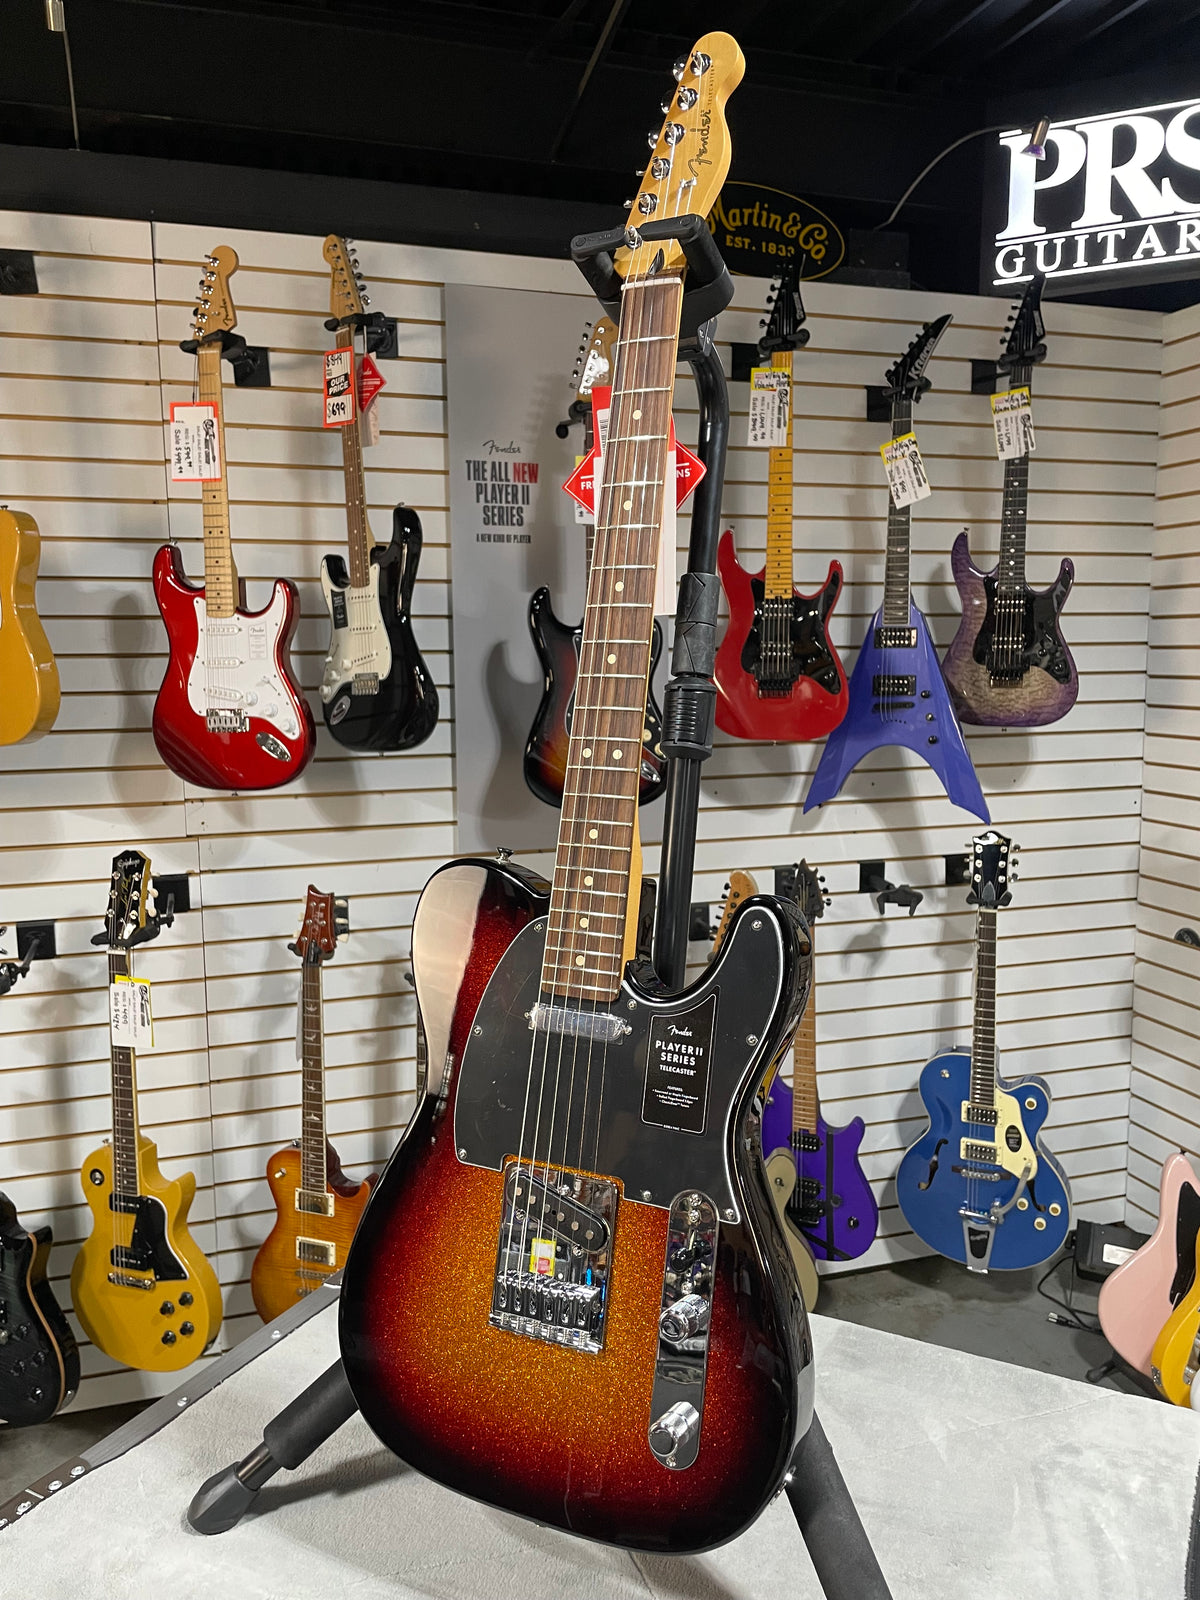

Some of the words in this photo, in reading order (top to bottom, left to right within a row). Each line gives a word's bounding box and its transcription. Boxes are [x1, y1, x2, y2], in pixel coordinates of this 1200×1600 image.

[687, 109, 713, 177] Fender
[995, 104, 1200, 240] PRS
[725, 234, 756, 251] EST.
[329, 381, 349, 396] PRICE
[330, 375, 345, 386] OUR
[482, 439, 521, 455] Fender
[466, 459, 487, 481] THE
[491, 461, 510, 482] ALL
[513, 462, 539, 483] NEW
[476, 483, 519, 505] PLAYER
[522, 485, 530, 505] II
[483, 505, 524, 527] SERIES
[667, 1024, 693, 1037] Fender
[655, 1040, 693, 1055] PLAYER
[696, 1047, 703, 1056] II
[660, 1052, 696, 1066] SERIES
